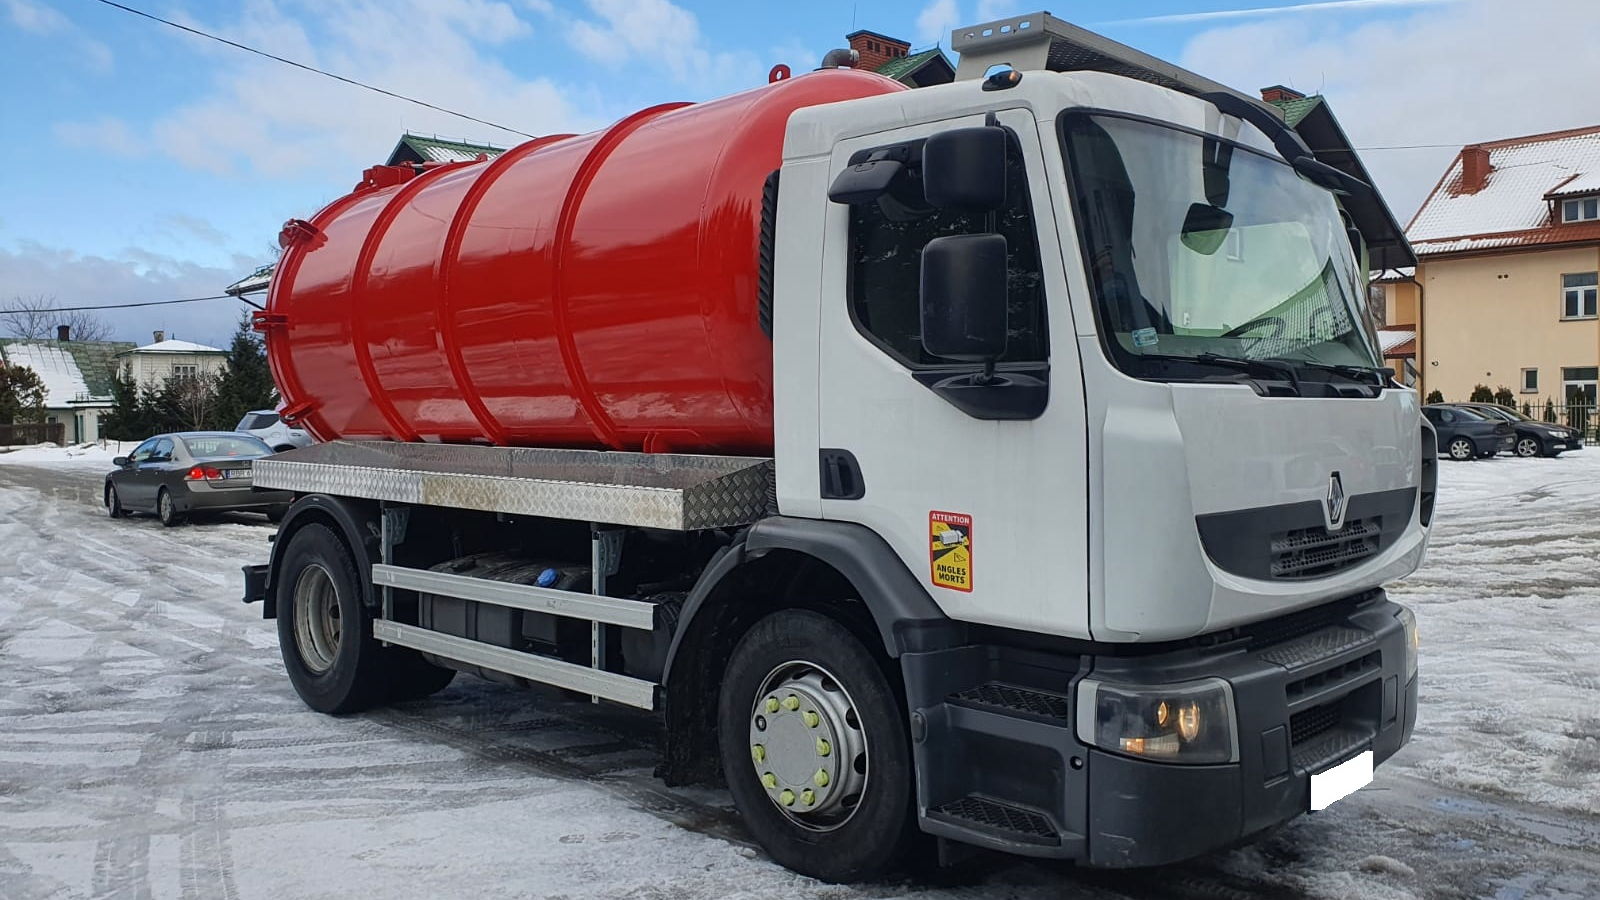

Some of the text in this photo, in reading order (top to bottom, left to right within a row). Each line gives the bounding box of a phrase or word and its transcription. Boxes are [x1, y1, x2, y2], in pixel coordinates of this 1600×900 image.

[932, 513, 969, 524] ATTENTION
[937, 564, 966, 576] ANGLES
[939, 573, 965, 584] MORTS
